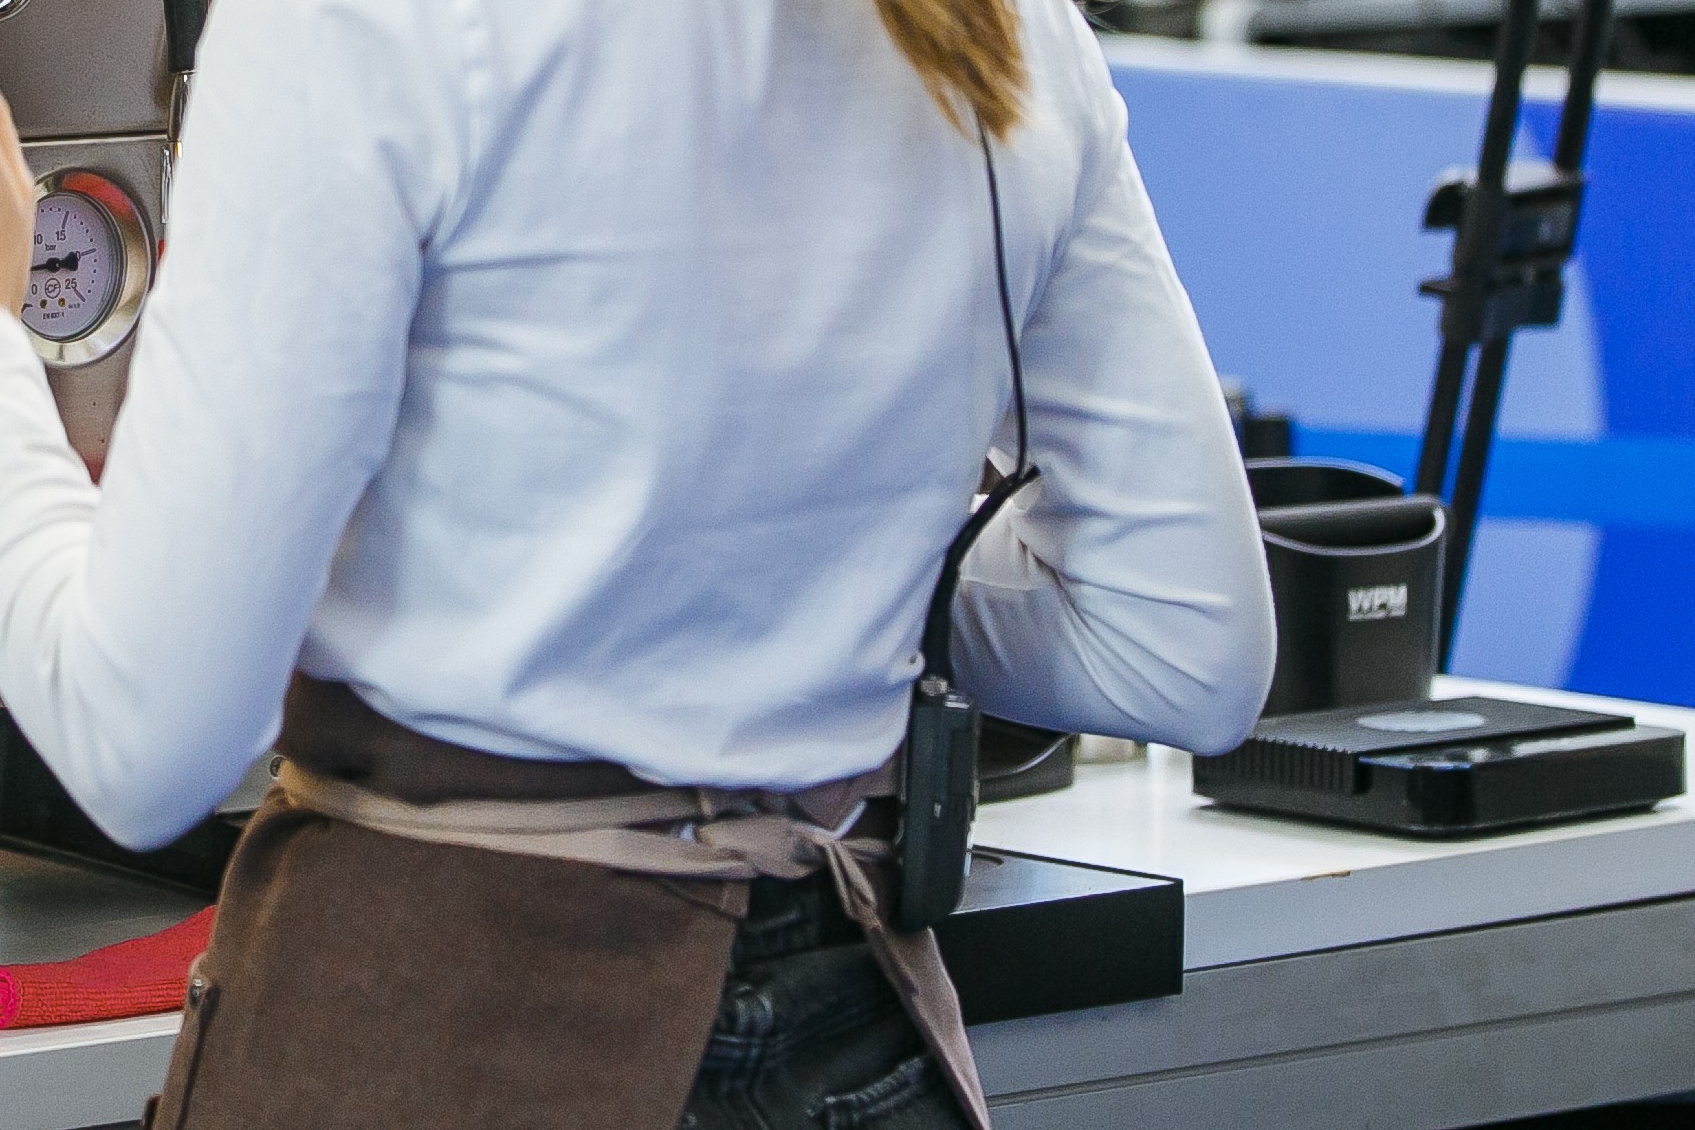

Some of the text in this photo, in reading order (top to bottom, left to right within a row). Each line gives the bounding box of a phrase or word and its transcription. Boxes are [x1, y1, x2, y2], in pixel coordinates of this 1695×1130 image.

[56, 230, 66, 241] 15
[31, 283, 37, 295] 0
[65, 278, 77, 290] 25
